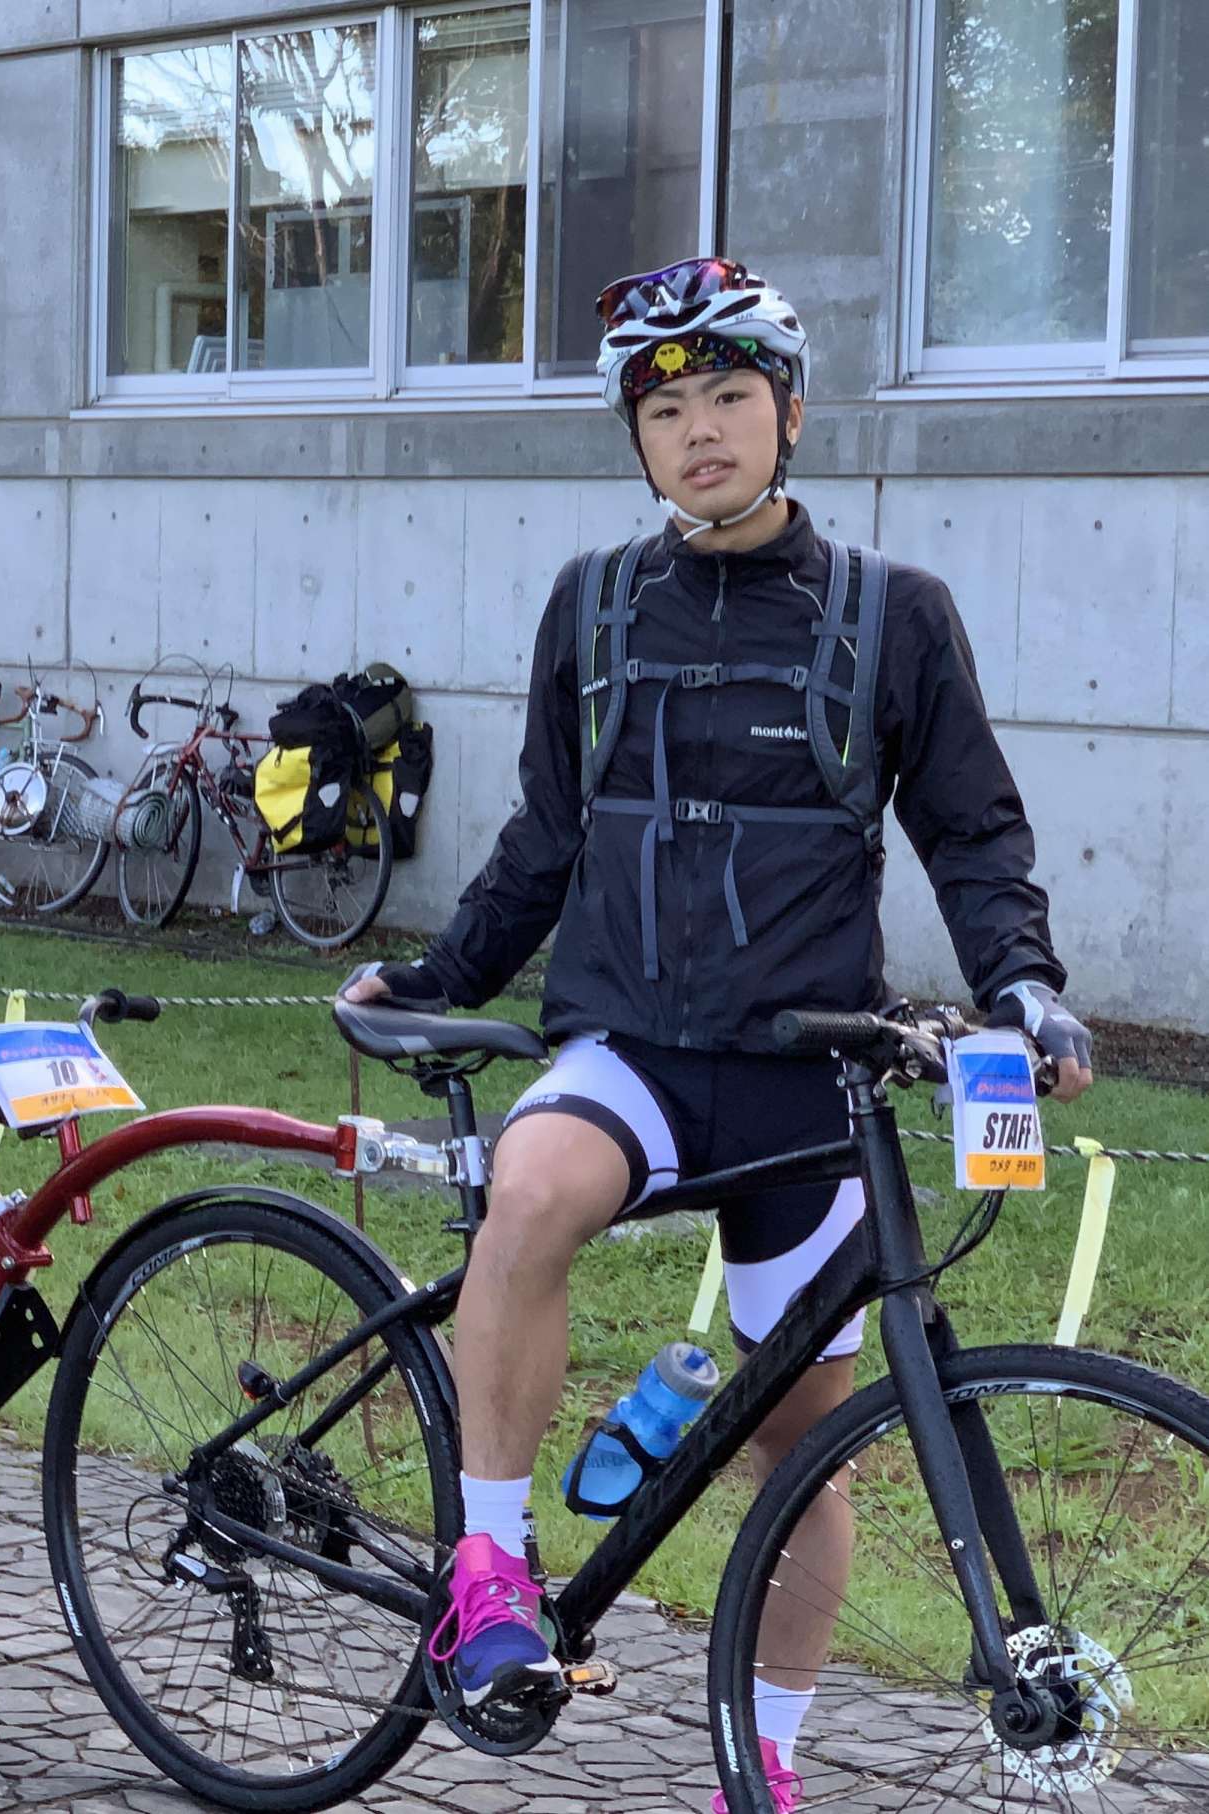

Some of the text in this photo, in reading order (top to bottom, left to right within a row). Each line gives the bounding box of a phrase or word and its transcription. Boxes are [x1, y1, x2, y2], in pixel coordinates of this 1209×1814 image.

[46, 1059, 79, 1087] 10
[982, 1111, 1032, 1150] STAFF
[719, 1701, 741, 1773] MERIDA
